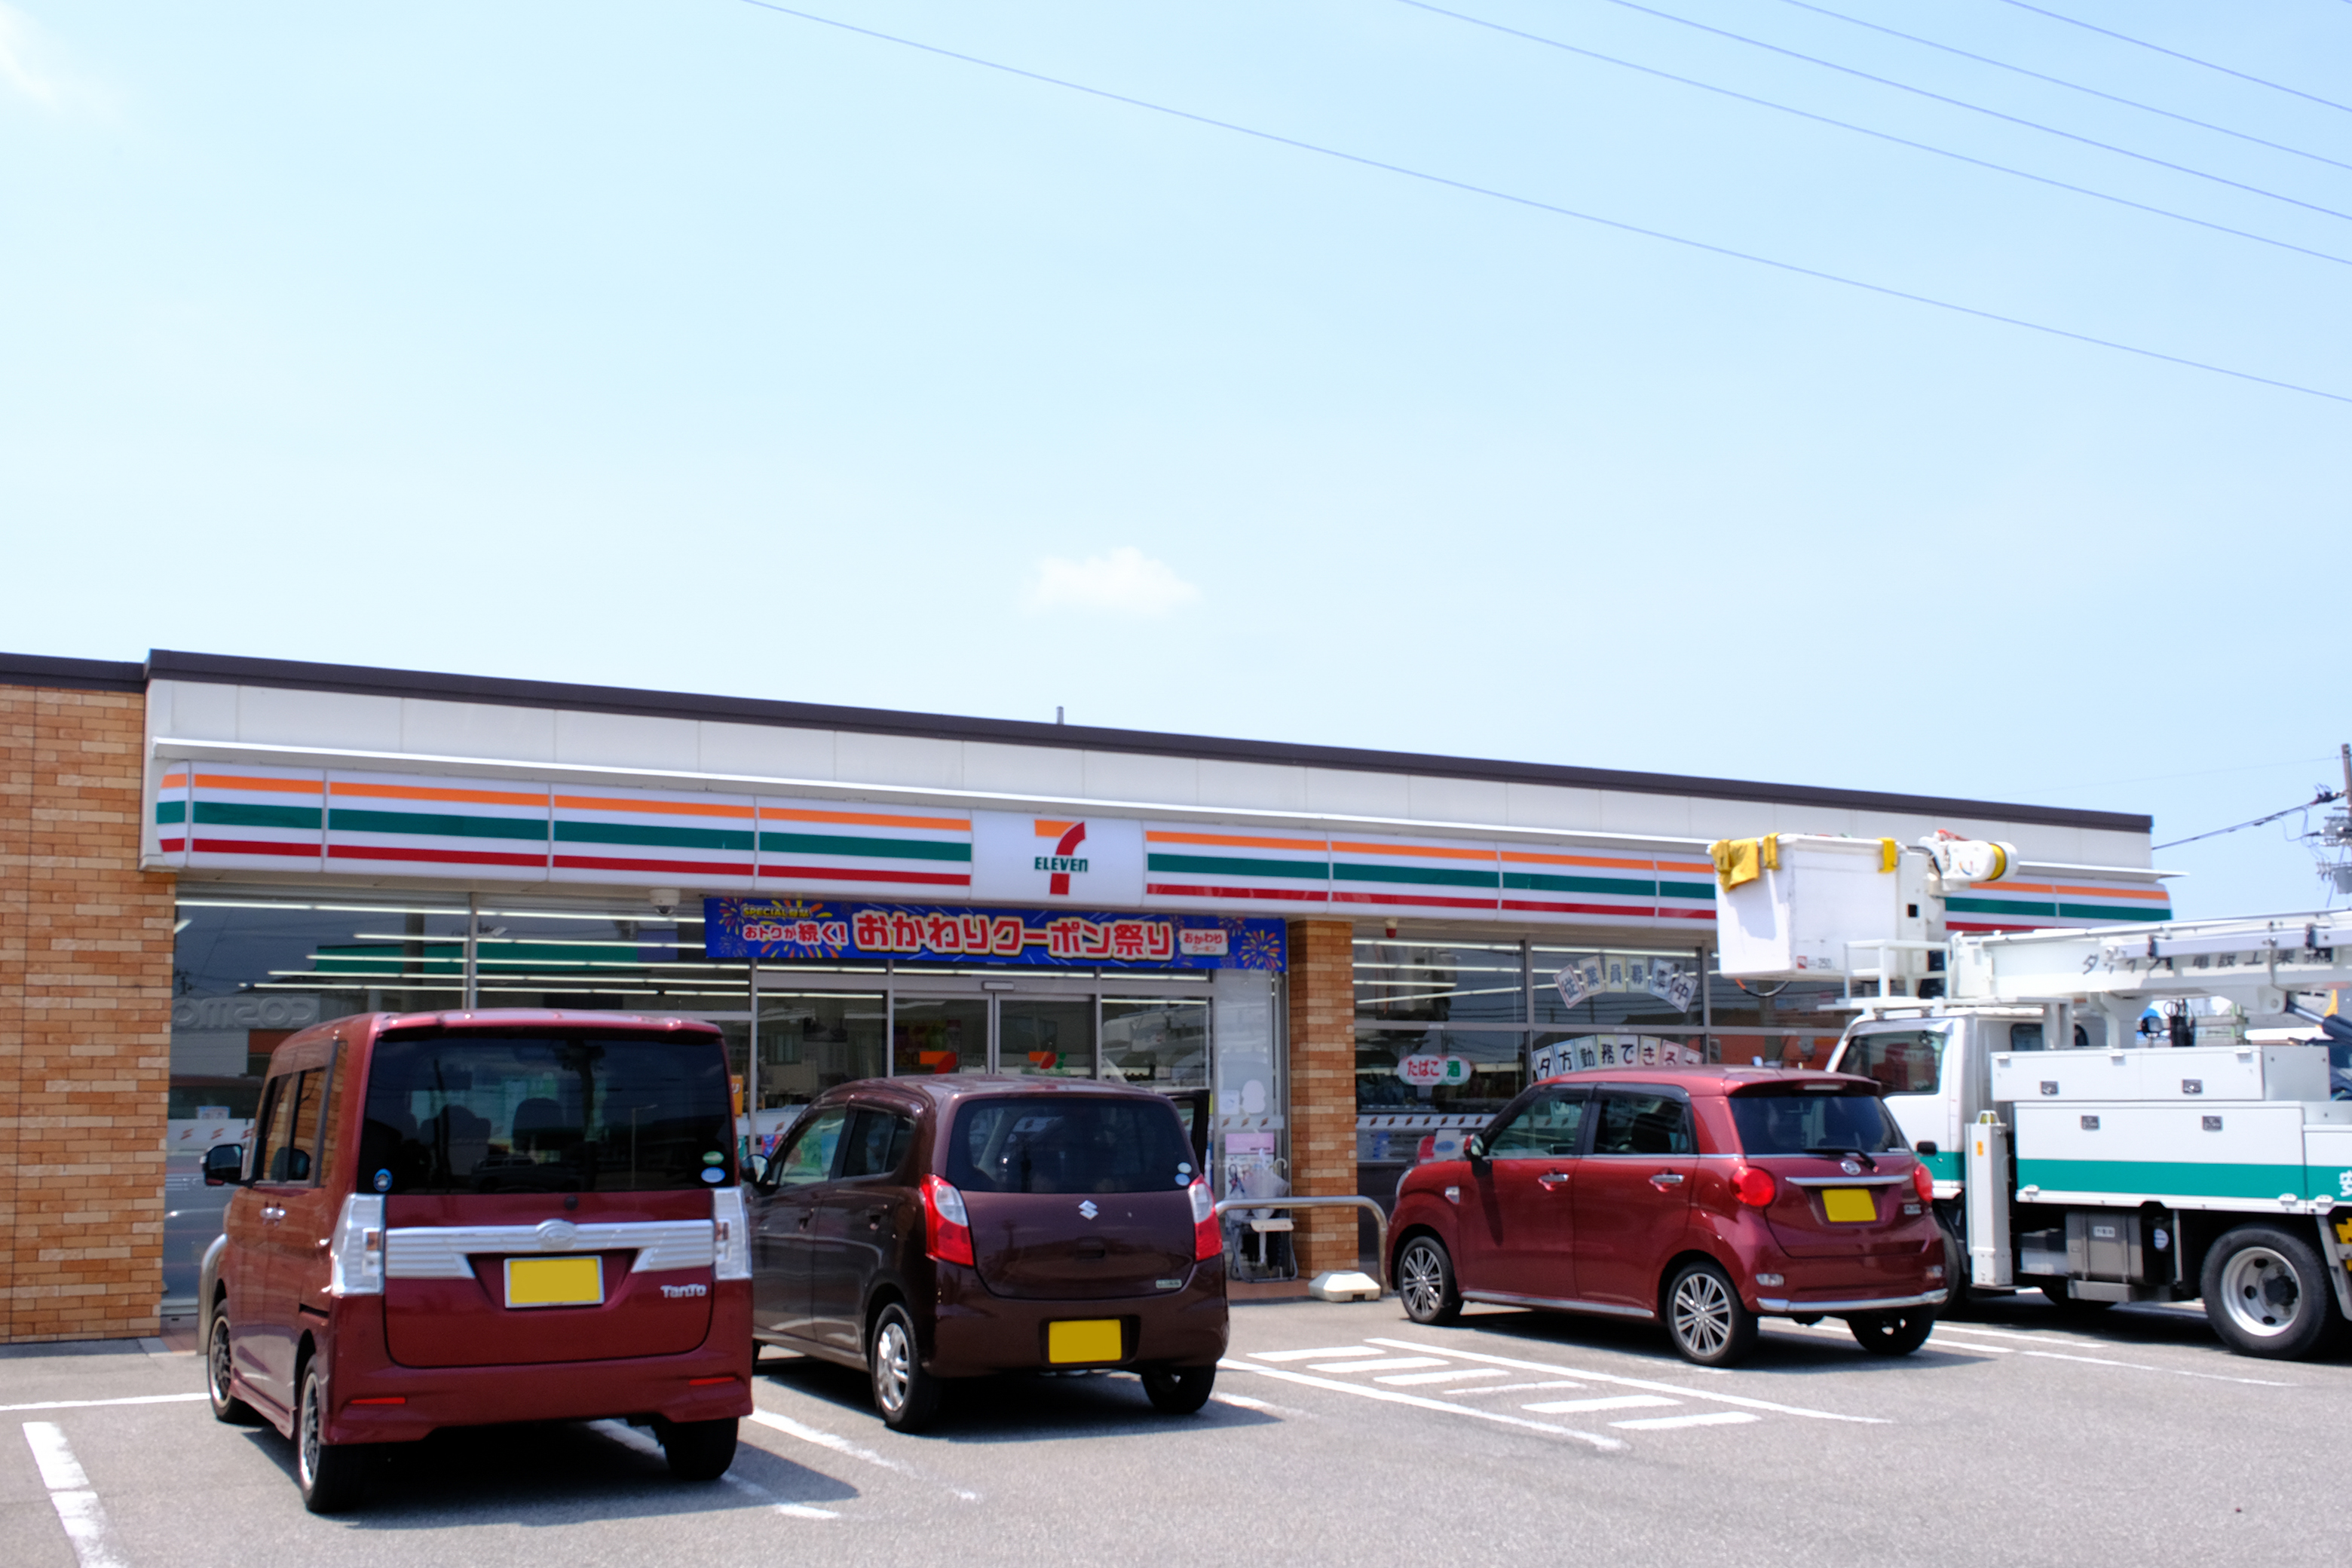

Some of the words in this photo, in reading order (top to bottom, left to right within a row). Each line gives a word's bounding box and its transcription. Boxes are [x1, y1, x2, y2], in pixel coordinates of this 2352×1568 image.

[743, 907, 787, 917] SPECIAL
[853, 911, 1171, 959] おかわりクーポン祭り
[1184, 933, 1223, 944] おかわり
[1407, 1059, 1440, 1077] たばこ
[1446, 1060, 1461, 1078] 酒
